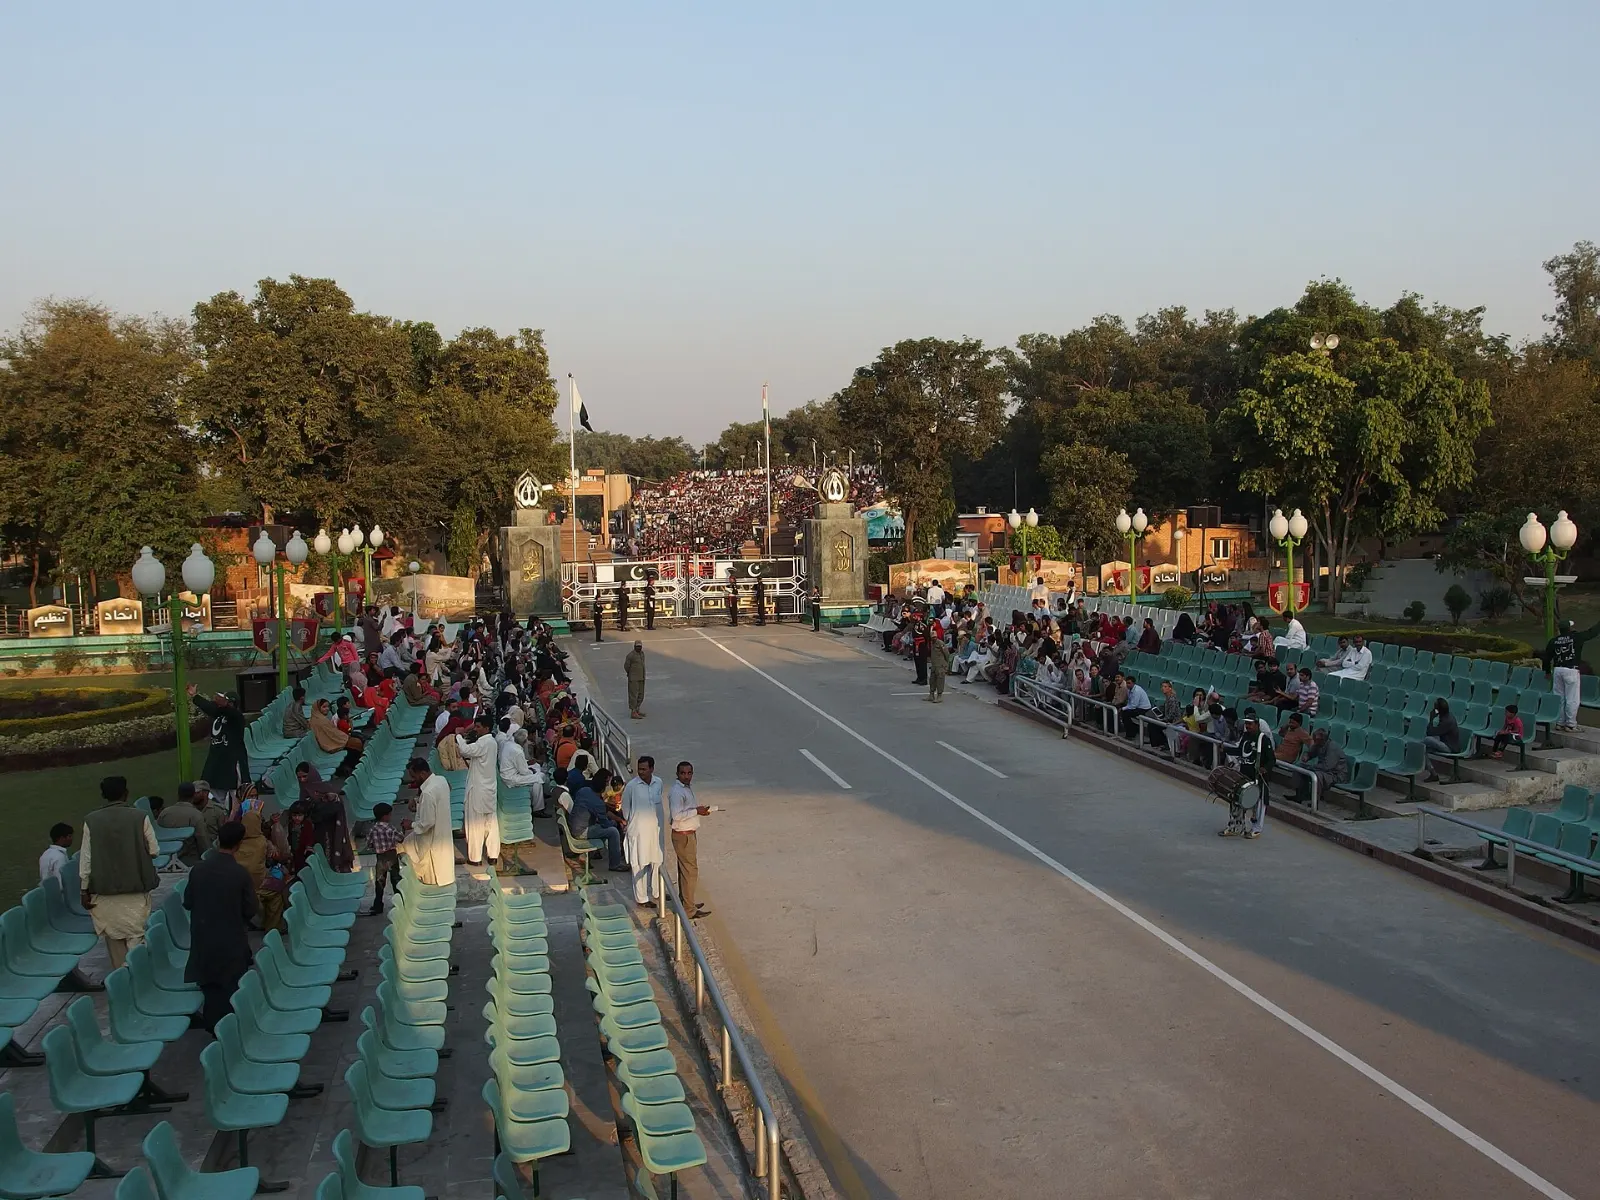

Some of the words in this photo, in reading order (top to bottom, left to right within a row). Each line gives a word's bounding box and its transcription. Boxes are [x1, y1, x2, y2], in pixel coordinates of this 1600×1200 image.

[1154, 572, 1178, 584] اتحاد
[34, 611, 67, 629] تنظیم
[104, 607, 137, 621] اتحاد
[180, 607, 206, 622] ایما
